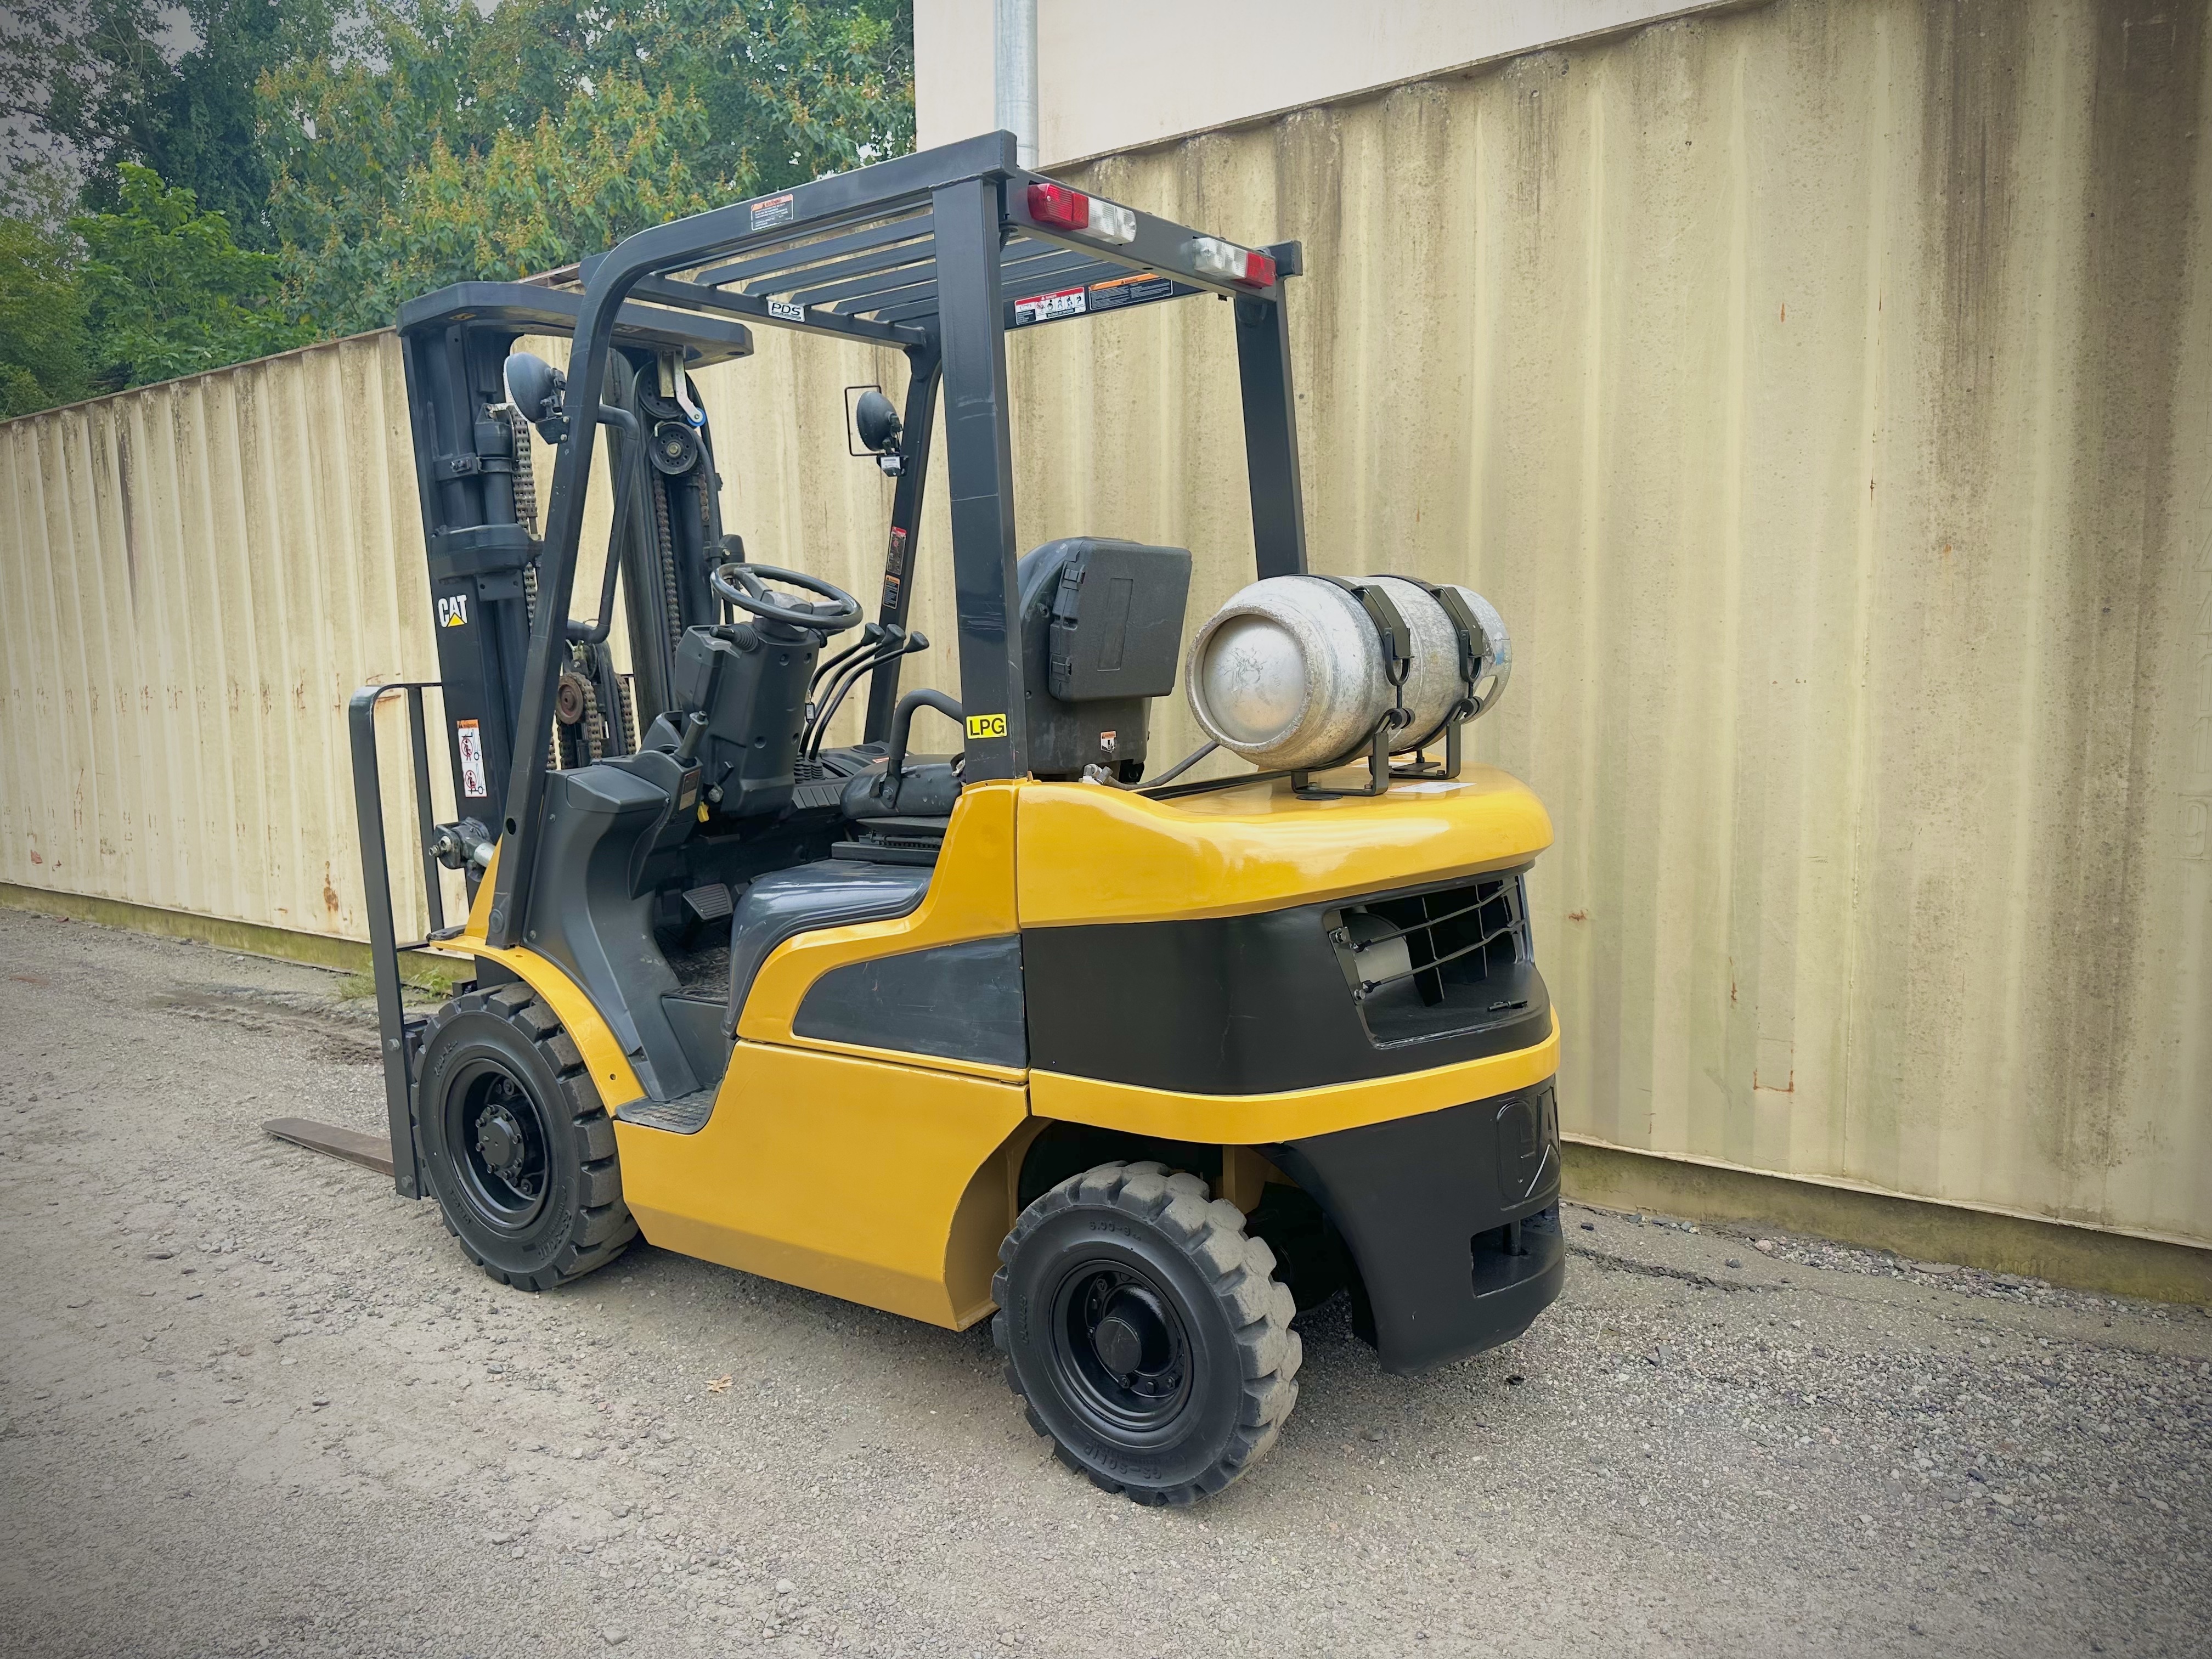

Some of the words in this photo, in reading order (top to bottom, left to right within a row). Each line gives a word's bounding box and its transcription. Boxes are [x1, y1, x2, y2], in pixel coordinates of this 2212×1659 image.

[771, 302, 802, 316] PDS
[438, 594, 467, 628] CAT
[969, 718, 1005, 736] LPG
